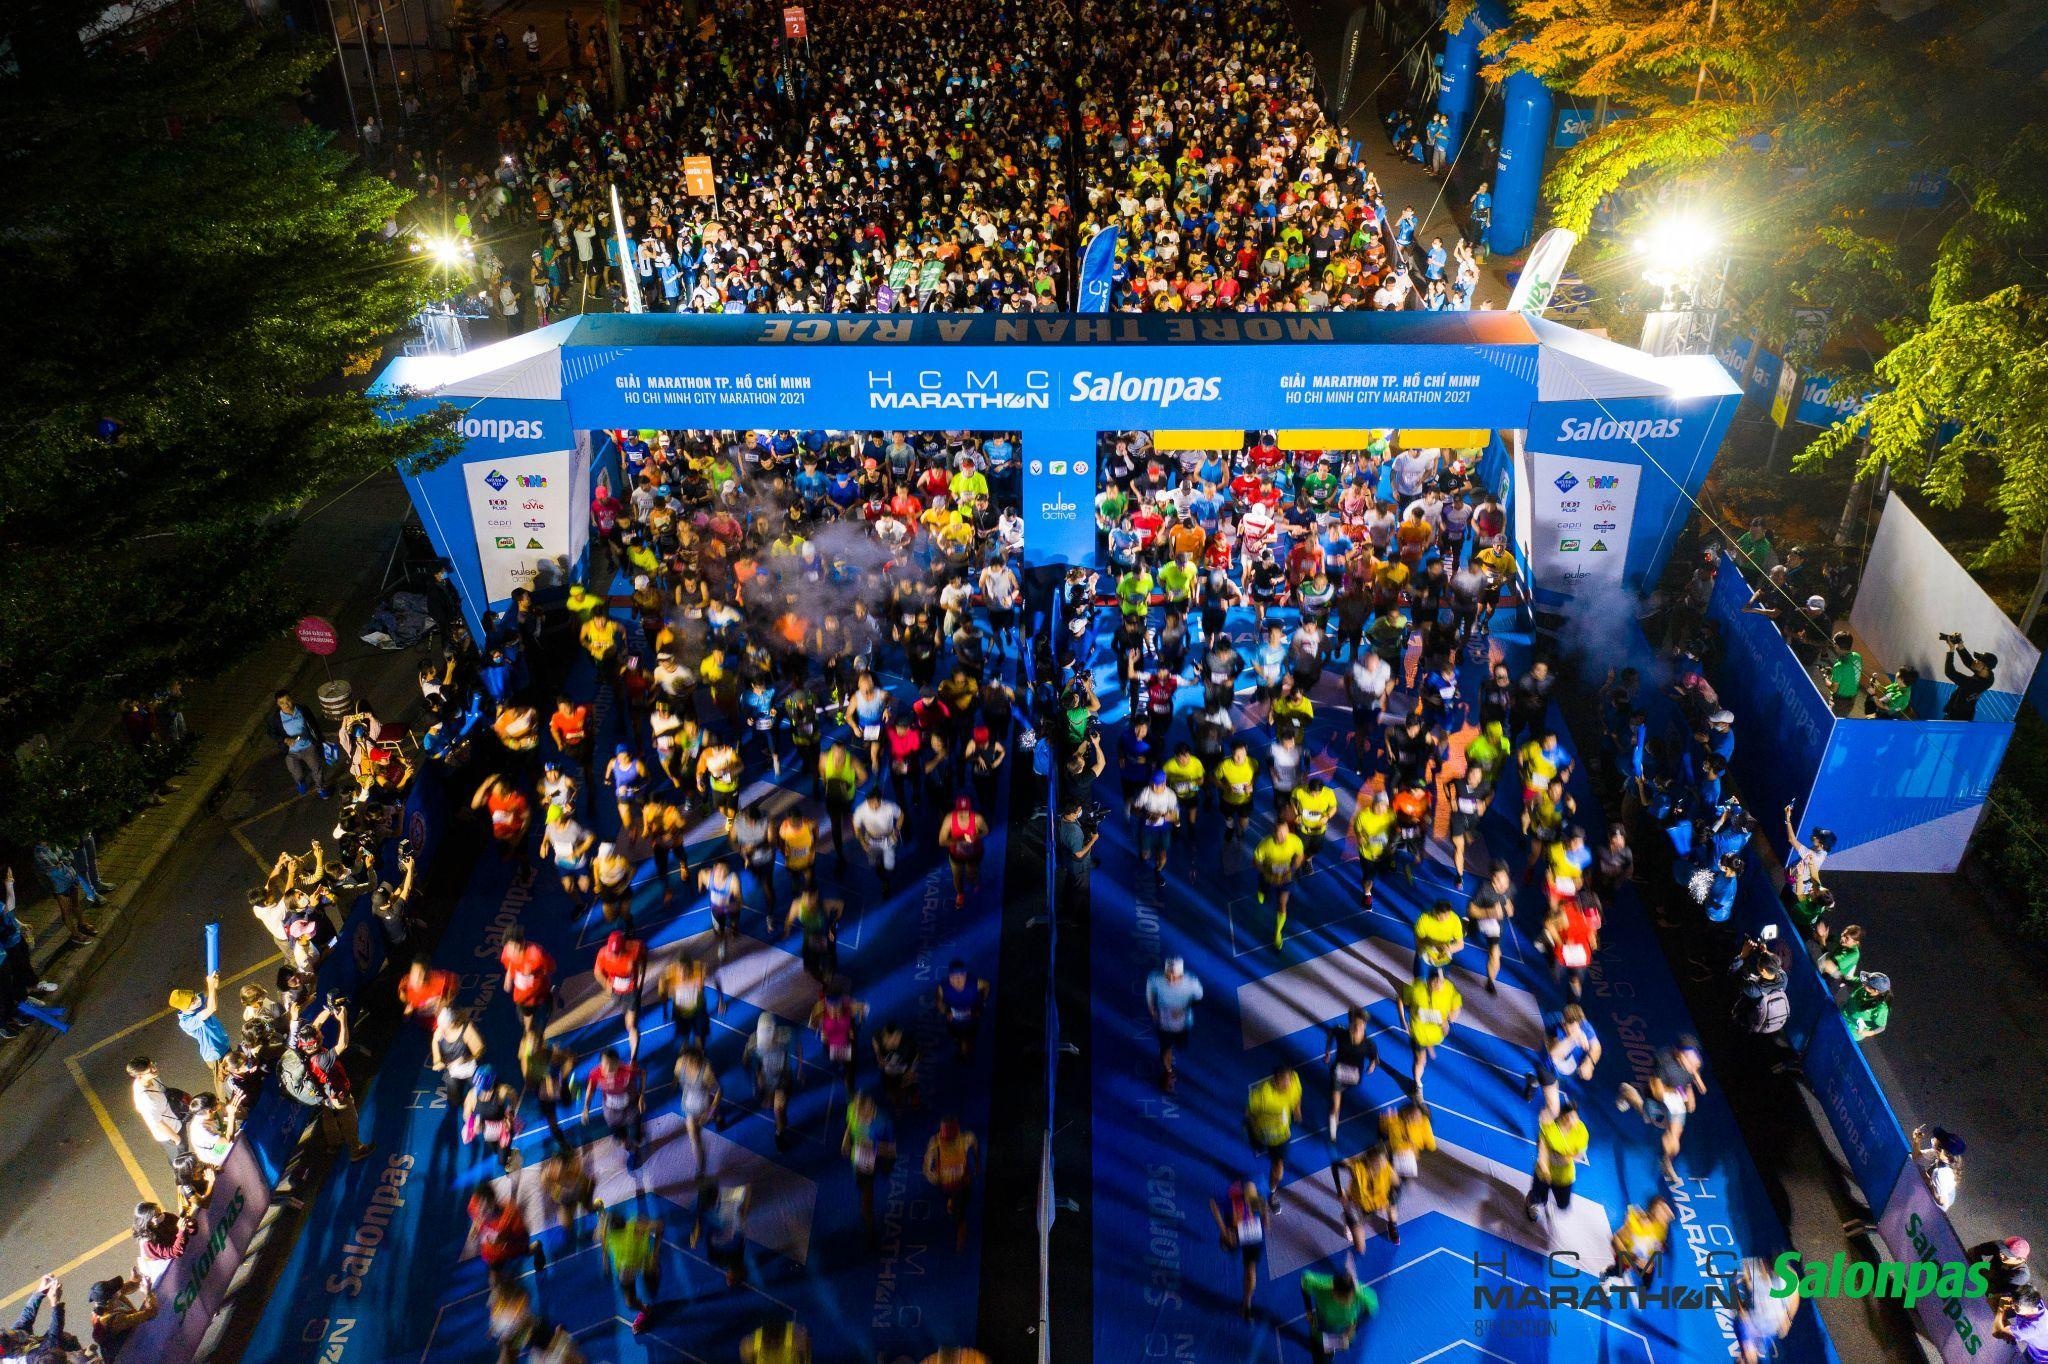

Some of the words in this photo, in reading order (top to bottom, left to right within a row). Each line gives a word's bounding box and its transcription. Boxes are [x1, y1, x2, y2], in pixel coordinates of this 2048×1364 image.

[792, 23, 800, 34] 2
[696, 177, 704, 190] 1
[758, 318, 914, 342] RACE
[936, 319, 973, 342] A
[994, 318, 1148, 342] THAN
[1165, 318, 1334, 341] MORE
[615, 373, 641, 389] GIẢI
[647, 377, 712, 389] MARATHON
[715, 377, 733, 389] TP.
[756, 374, 777, 389] CHÍ
[780, 377, 811, 389] MINH
[1069, 370, 1222, 408] Salonpas
[1280, 372, 1306, 388] GIẢI
[1312, 375, 1379, 388] MARATHON
[1382, 375, 1399, 388] TP.
[1423, 372, 1446, 387] CHÍ
[1449, 375, 1480, 387] MINH
[624, 392, 640, 404] HO
[643, 392, 661, 404] CHI
[664, 392, 692, 404] MINH
[694, 392, 717, 404] CITY
[720, 392, 777, 405] MARATHON
[780, 392, 805, 405] 2021
[869, 392, 1049, 409] MARATHON
[1286, 391, 1301, 404] HO
[1304, 391, 1323, 404] CHI
[1326, 391, 1354, 403] MINH
[1356, 391, 1381, 403] CITY
[1382, 390, 1441, 403] MARATHON
[1444, 390, 1471, 403] 2021
[456, 417, 543, 443] lonpas
[1557, 417, 1683, 444] Salonpas
[1042, 491, 1077, 512] pulse
[1042, 511, 1077, 520] active
[1557, 522, 1582, 530] capri
[511, 561, 537, 576] pulse
[326, 1152, 415, 1297] Salonpas
[1144, 1163, 1185, 1311] Salonpas
[173, 1185, 245, 1328] Salonpas
